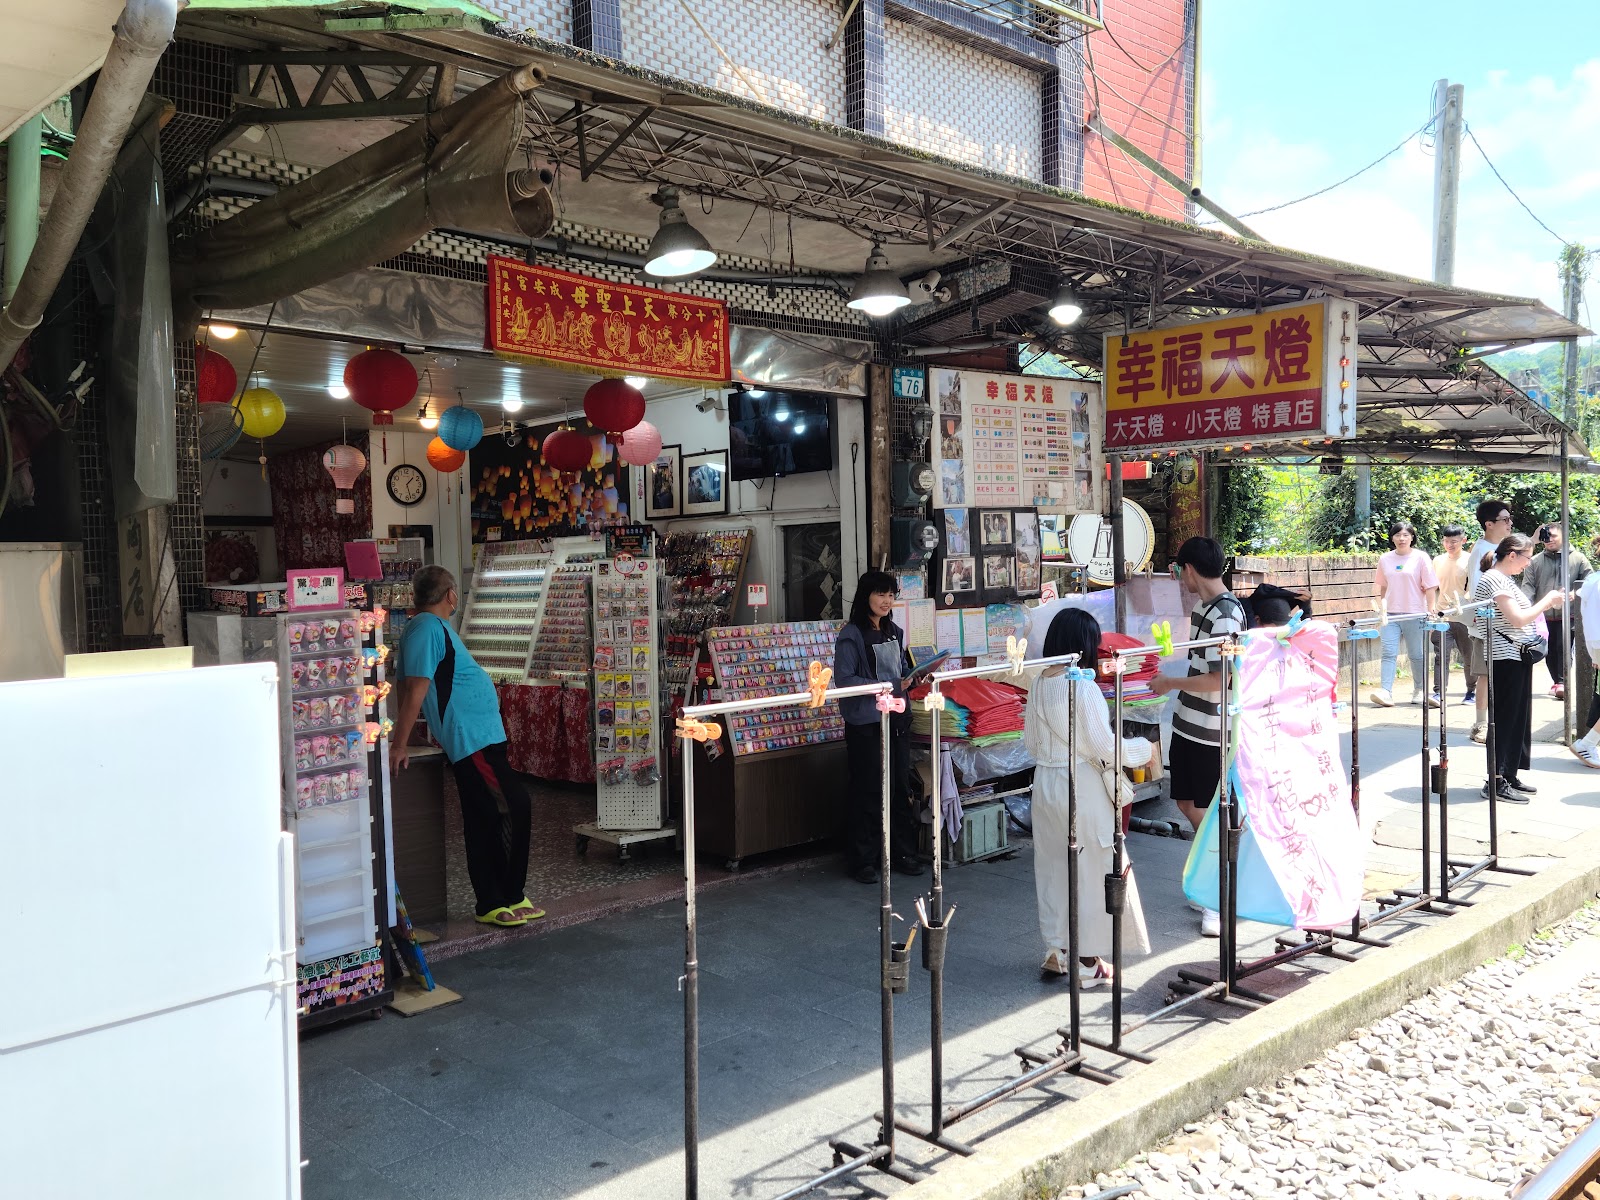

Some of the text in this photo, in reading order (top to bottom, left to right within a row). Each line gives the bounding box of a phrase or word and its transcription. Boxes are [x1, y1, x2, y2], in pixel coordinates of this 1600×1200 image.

[571, 286, 660, 321] 天上聖母
[1117, 314, 1313, 403] 幸福天燈
[906, 378, 919, 395] 76
[986, 380, 1054, 404] 幸福天燈
[1252, 398, 1314, 428] 特賣店
